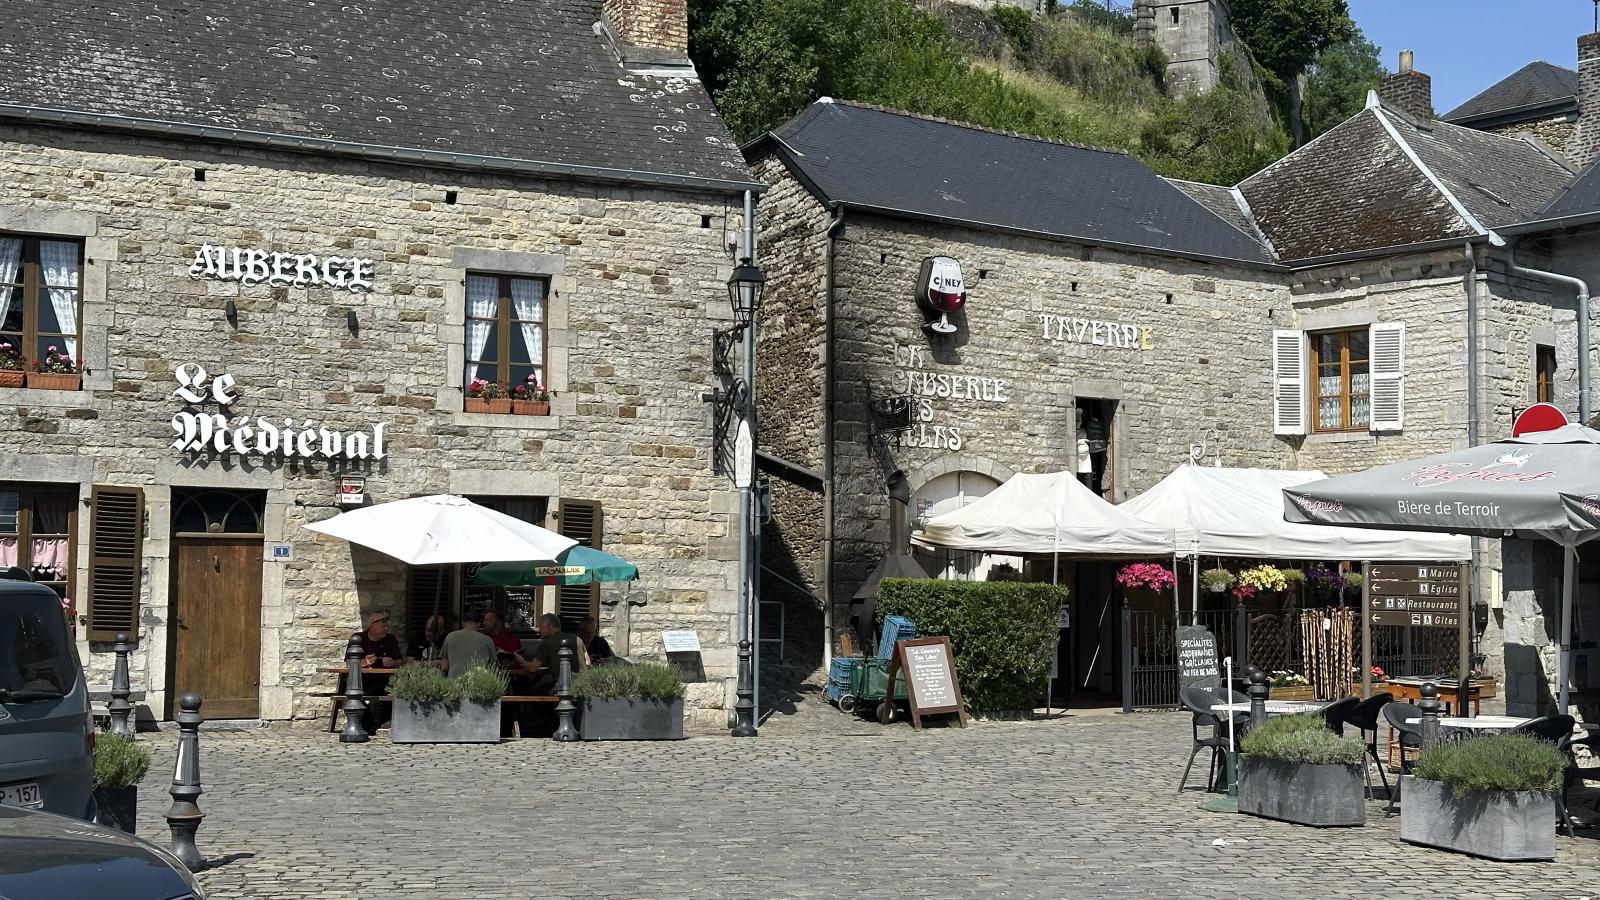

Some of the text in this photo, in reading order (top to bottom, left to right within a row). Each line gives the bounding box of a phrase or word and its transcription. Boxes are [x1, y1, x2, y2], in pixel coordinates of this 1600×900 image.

[188, 241, 375, 293] AUBERGE
[1038, 313, 1154, 350] TAVERNE
[172, 363, 237, 404] Le
[891, 370, 1007, 402] CAUSERIE
[170, 412, 388, 460] Médiéval
[900, 424, 961, 451] ILAS
[1398, 500, 1500, 517] Bière de Terroir
[1429, 569, 1458, 579] Mairie
[1430, 584, 1458, 595] Eglise
[1408, 599, 1458, 610] Restaurants
